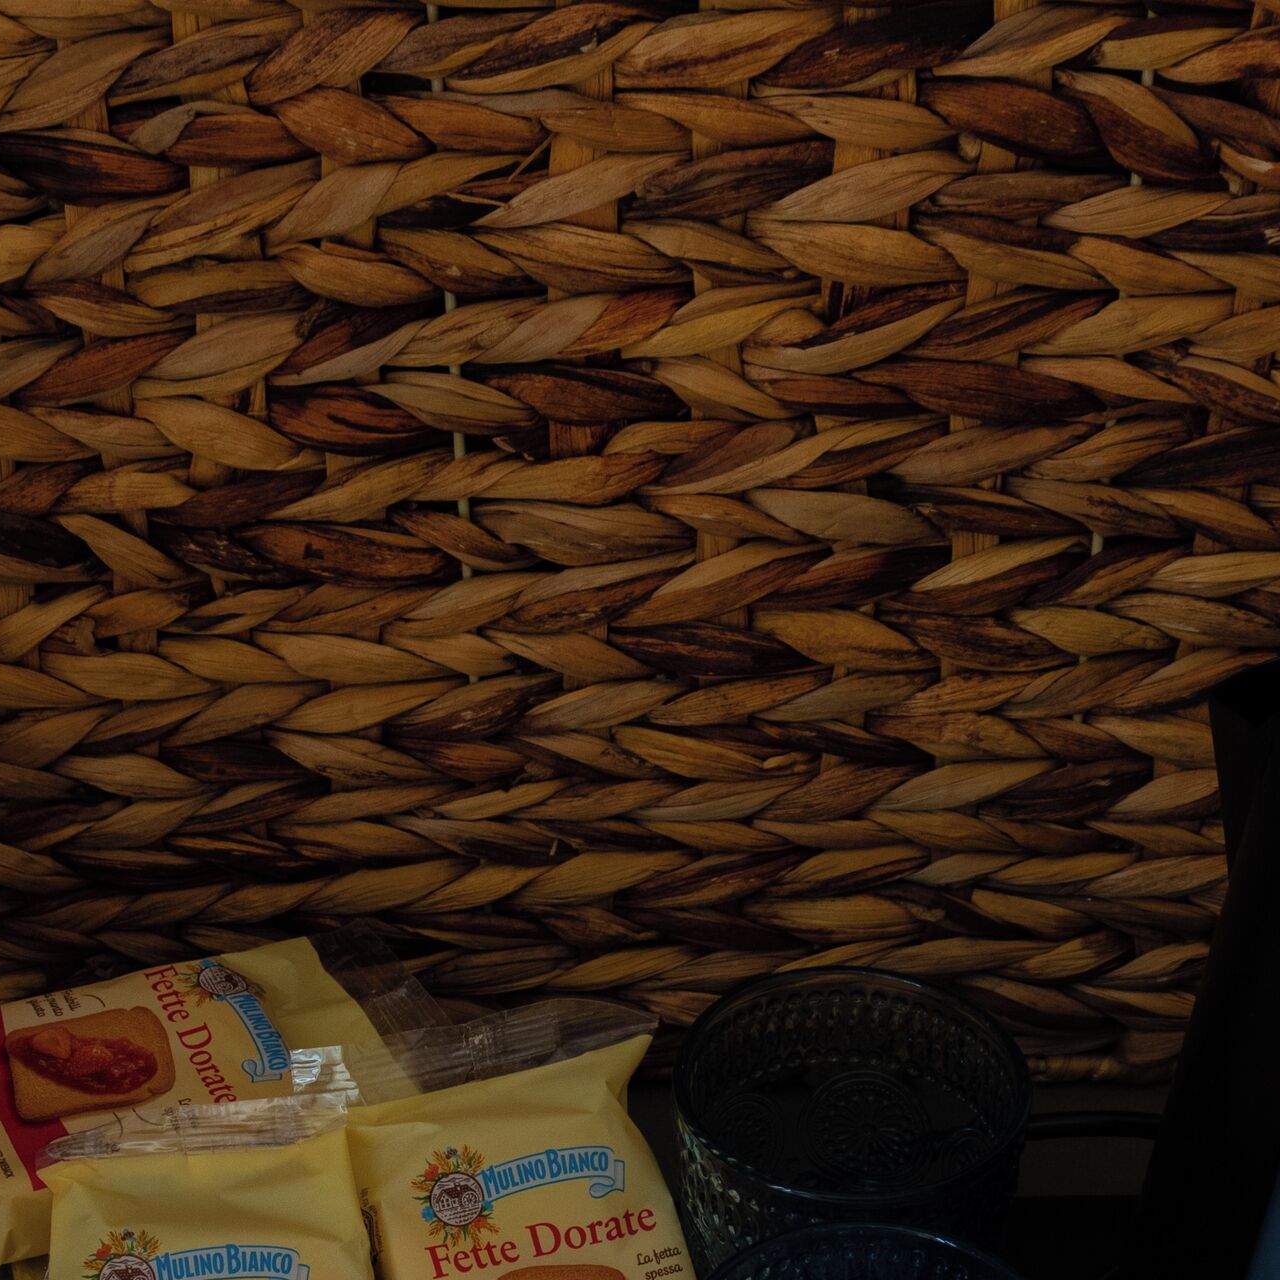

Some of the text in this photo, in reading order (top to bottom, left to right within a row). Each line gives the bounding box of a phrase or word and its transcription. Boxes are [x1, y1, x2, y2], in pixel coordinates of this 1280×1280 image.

[144, 965, 189, 1023] Fette
[176, 1022, 237, 1103] Dorate
[231, 992, 289, 1071] MULINO BIANCO
[482, 1150, 608, 1198] MULINO BIANCO
[226, 1244, 292, 1275] BIANCO
[425, 1208, 657, 1279] Fette Dorate
[636, 1247, 681, 1266] La fetta
